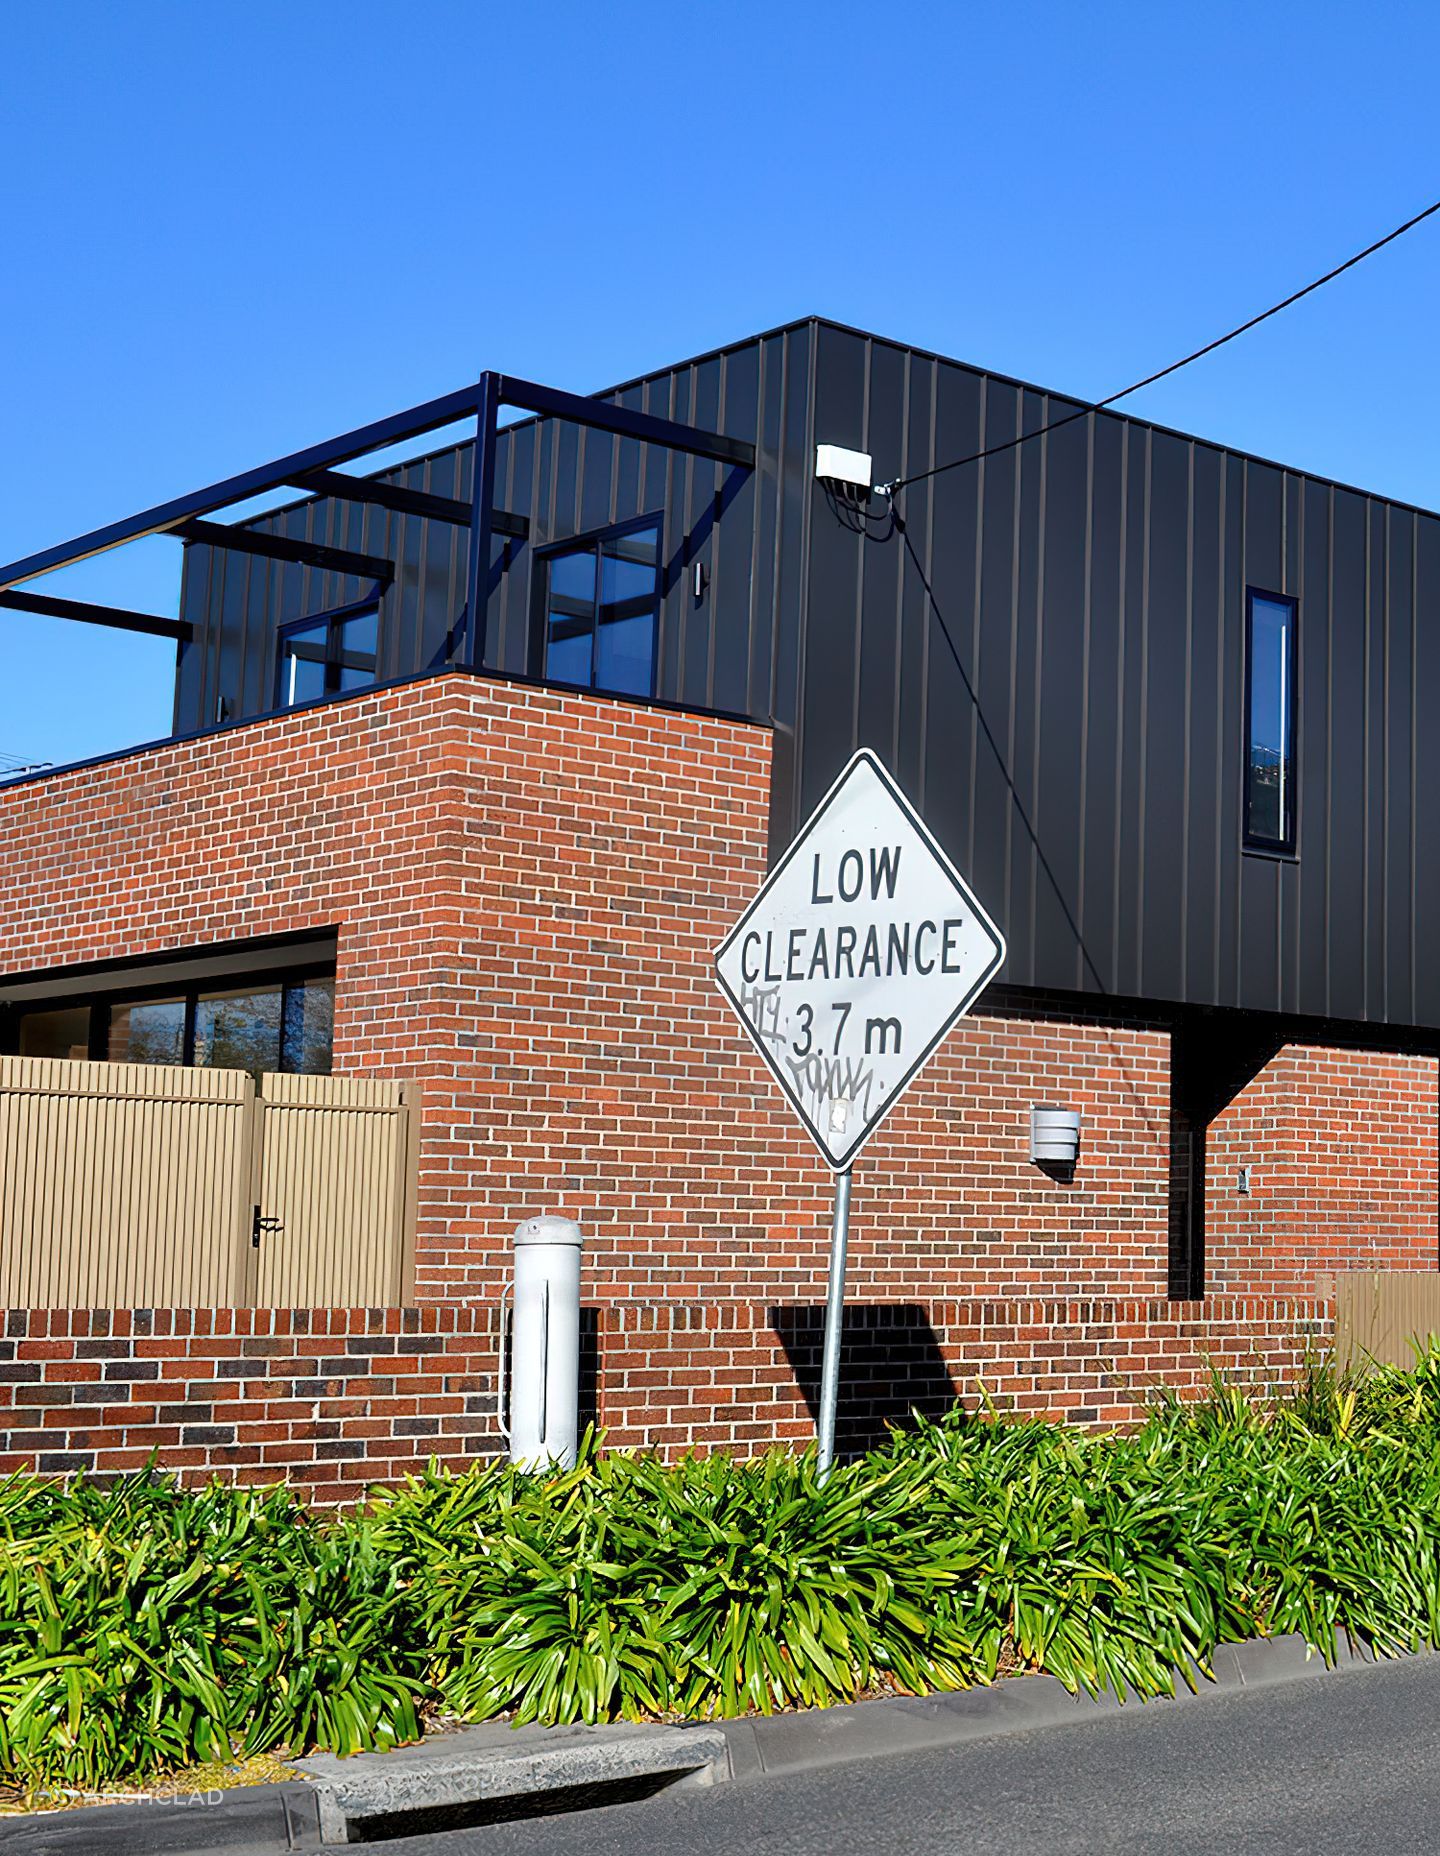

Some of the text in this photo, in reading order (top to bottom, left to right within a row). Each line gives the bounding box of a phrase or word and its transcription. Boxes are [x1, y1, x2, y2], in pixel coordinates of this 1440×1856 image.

[811, 846, 902, 905] LOW
[741, 919, 963, 983] CLEARANCE
[793, 1002, 852, 1056] 3.7
[865, 1017, 902, 1055] m
